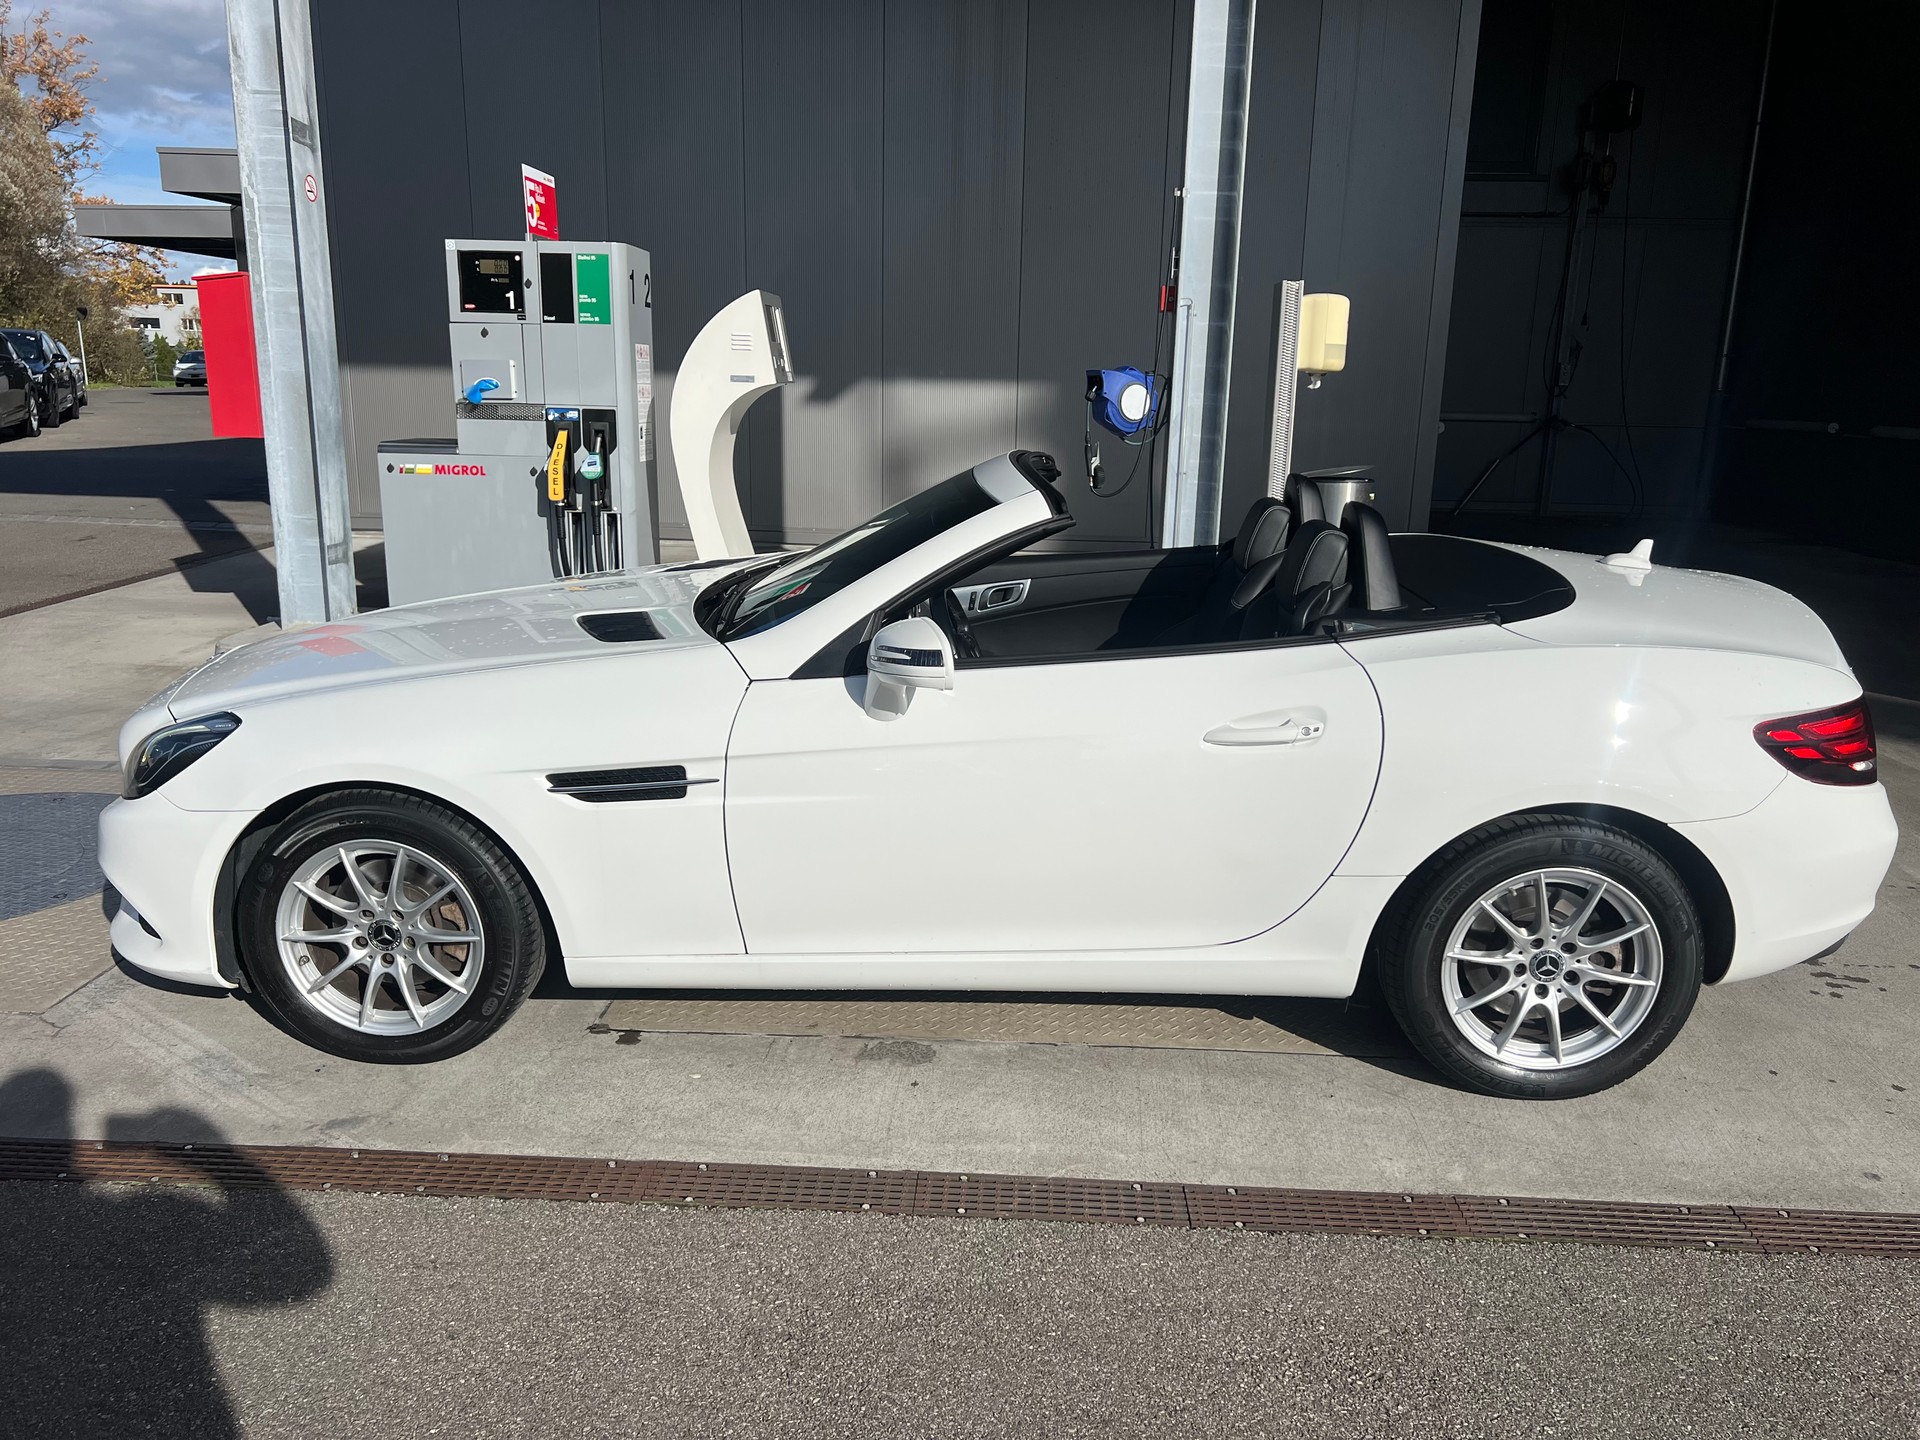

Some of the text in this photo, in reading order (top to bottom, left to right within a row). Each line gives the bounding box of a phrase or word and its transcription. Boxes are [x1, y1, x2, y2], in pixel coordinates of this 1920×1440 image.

[525, 180, 538, 228] 5
[505, 290, 515, 310] 1
[629, 269, 651, 309] 1 2
[434, 464, 486, 476] MIGROL
[552, 443, 563, 496] DIESEL
